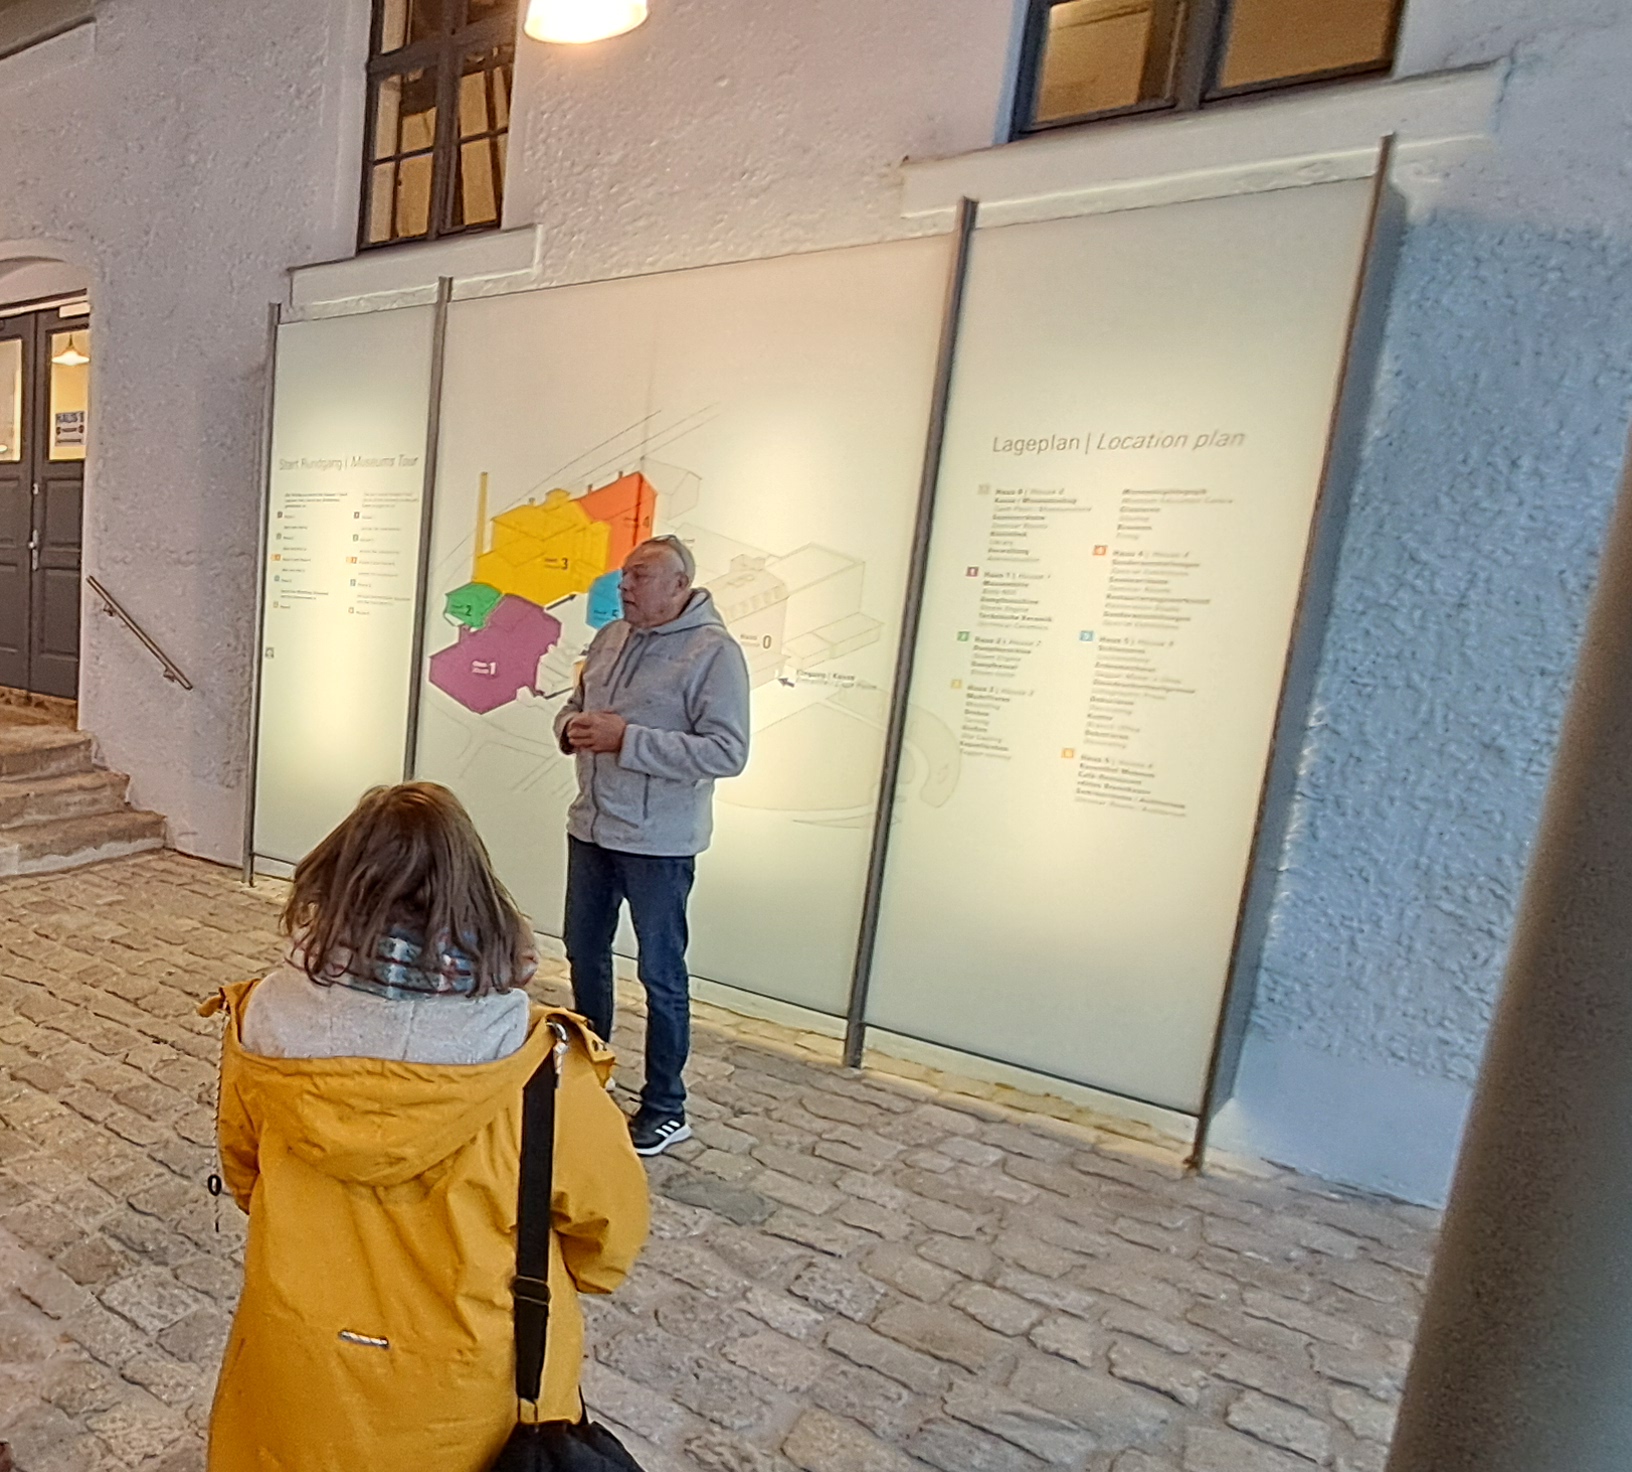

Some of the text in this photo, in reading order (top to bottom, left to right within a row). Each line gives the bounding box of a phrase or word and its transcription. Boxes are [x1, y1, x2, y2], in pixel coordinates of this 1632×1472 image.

[992, 434, 1080, 456] Lageplan
[1096, 430, 1189, 451] Location
[1192, 428, 1247, 451] plan
[301, 457, 343, 472] Rundgang
[350, 455, 396, 468] Museums
[397, 453, 420, 468] Tour
[562, 557, 569, 571] 3
[465, 604, 472, 617] 2
[762, 634, 772, 650] 0
[489, 661, 497, 675] 1
